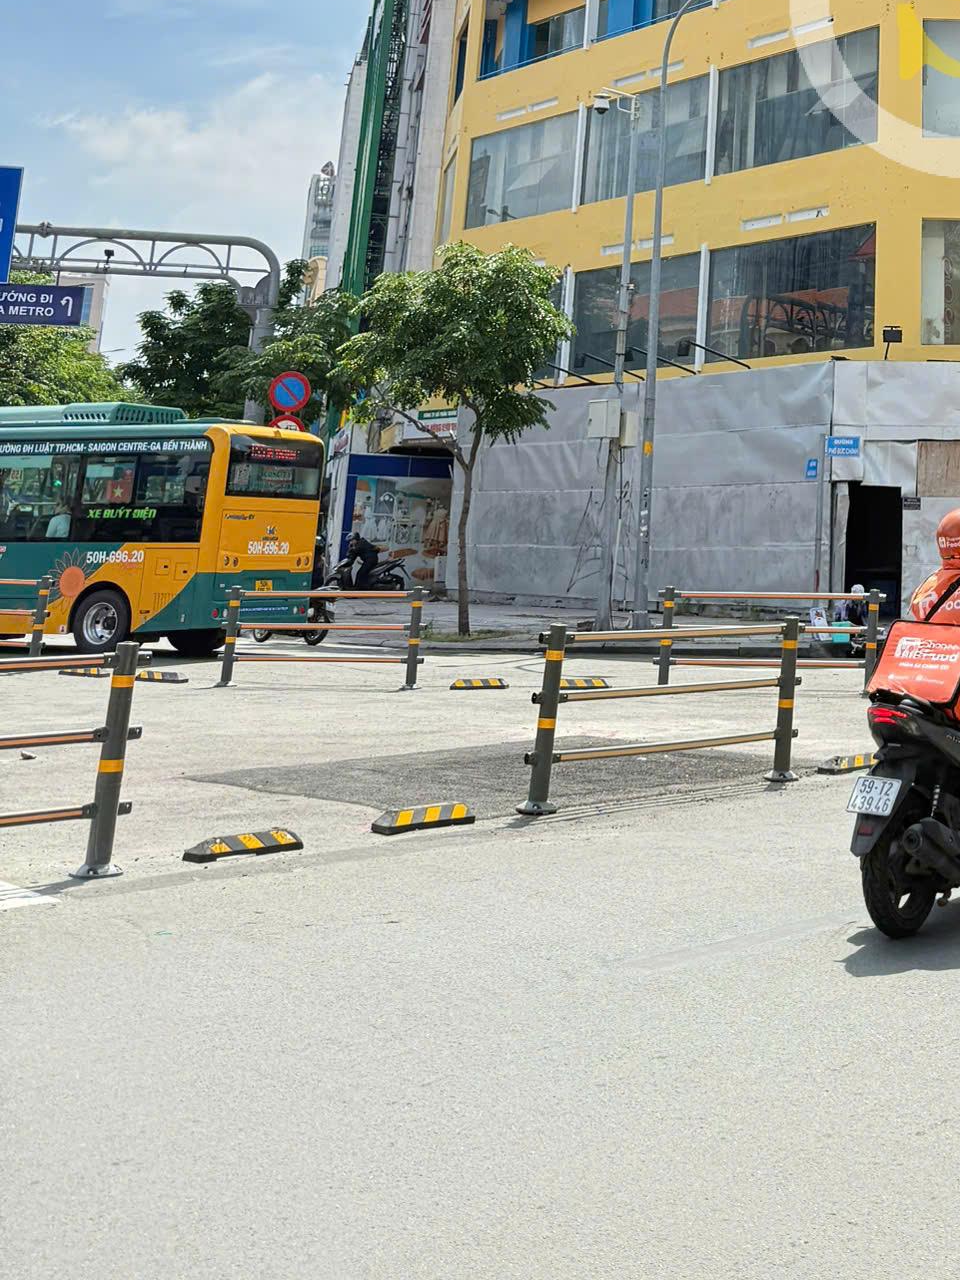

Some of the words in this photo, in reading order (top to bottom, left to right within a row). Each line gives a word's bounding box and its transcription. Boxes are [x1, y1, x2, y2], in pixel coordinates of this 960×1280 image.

[40, 293, 53, 304] ĐI
[8, 306, 55, 317] METRO
[22, 443, 34, 453] ĐH
[35, 442, 56, 454] LUẬT
[87, 442, 117, 452] SAIGON
[162, 439, 178, 450] BẾN
[180, 439, 208, 451] THÀNH
[87, 508, 102, 518] XE
[103, 506, 132, 519] BUÝT
[247, 540, 289, 556] 50H-696.20
[86, 550, 145, 565] 50H-696.20
[859, 778, 895, 797] 59-T2
[849, 794, 892, 814] 439.46
